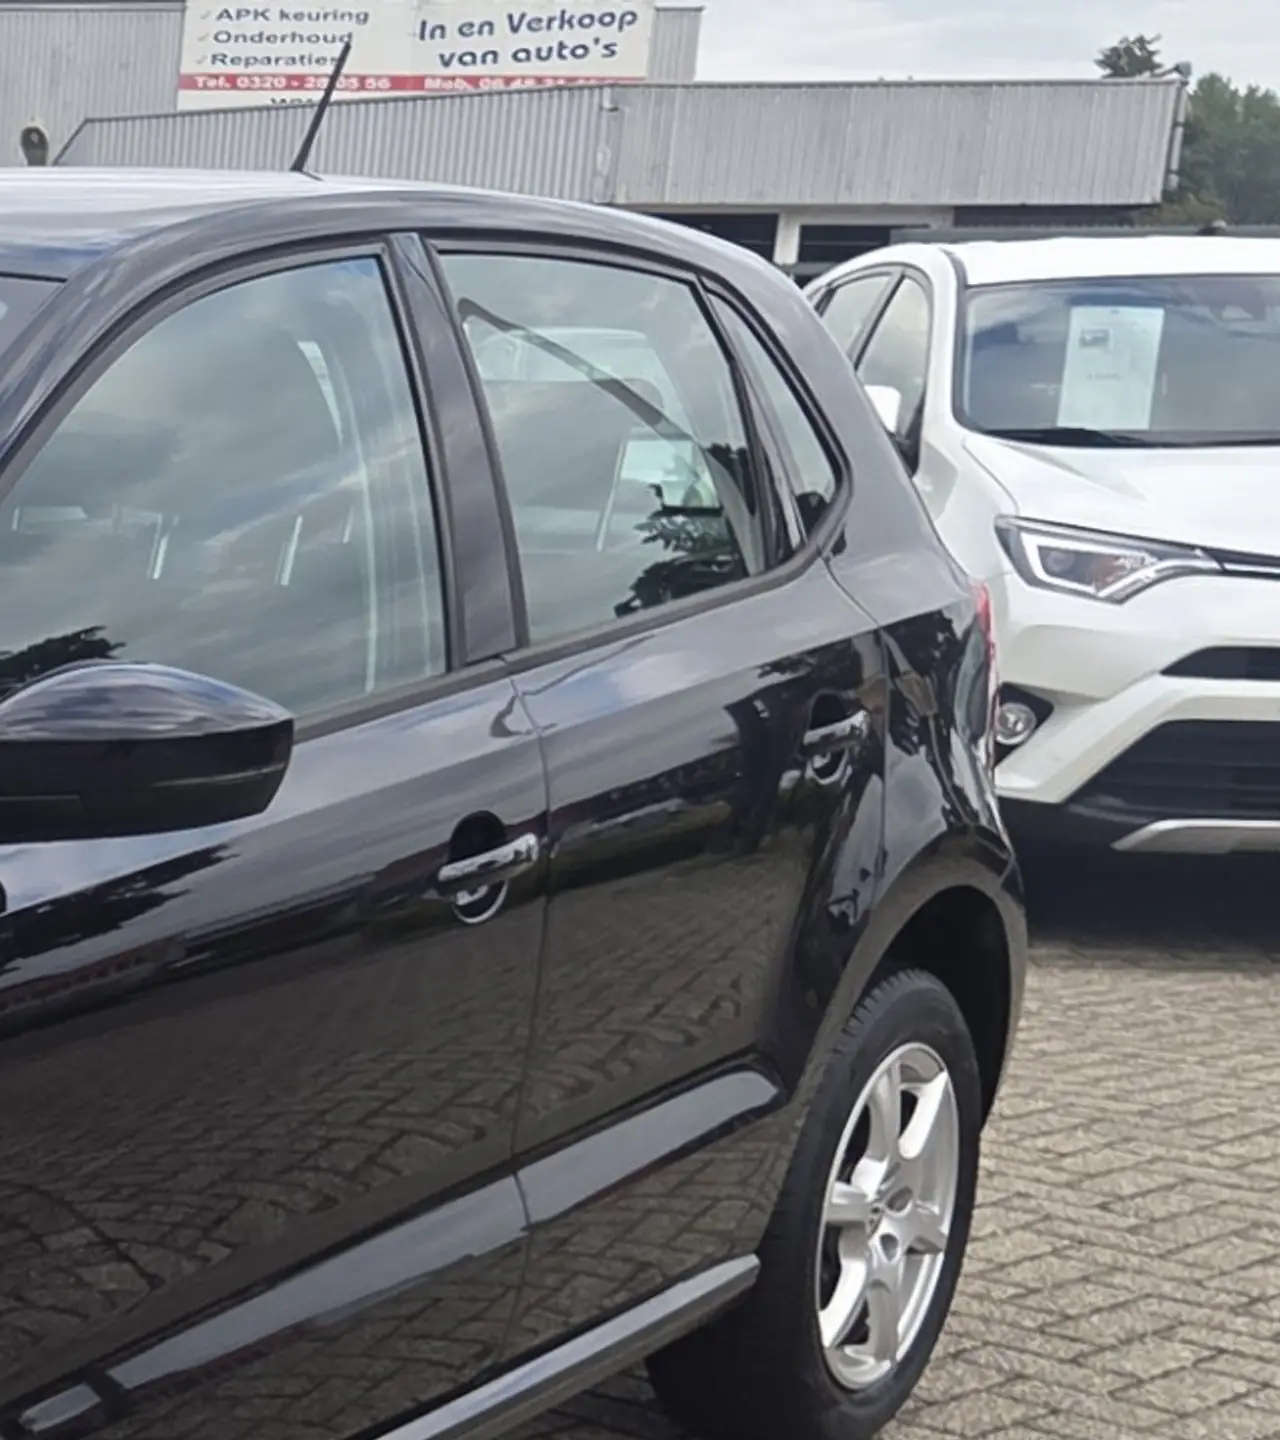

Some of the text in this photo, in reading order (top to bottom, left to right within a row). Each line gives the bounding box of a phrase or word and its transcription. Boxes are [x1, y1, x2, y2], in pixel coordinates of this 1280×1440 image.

[216, 8, 369, 25] APK keuring
[419, 9, 638, 41] In en Verkoop
[213, 30, 353, 45] Onderhoud
[439, 37, 618, 68] van auto's
[193, 75, 232, 89] Tel.
[236, 75, 287, 89] 0320
